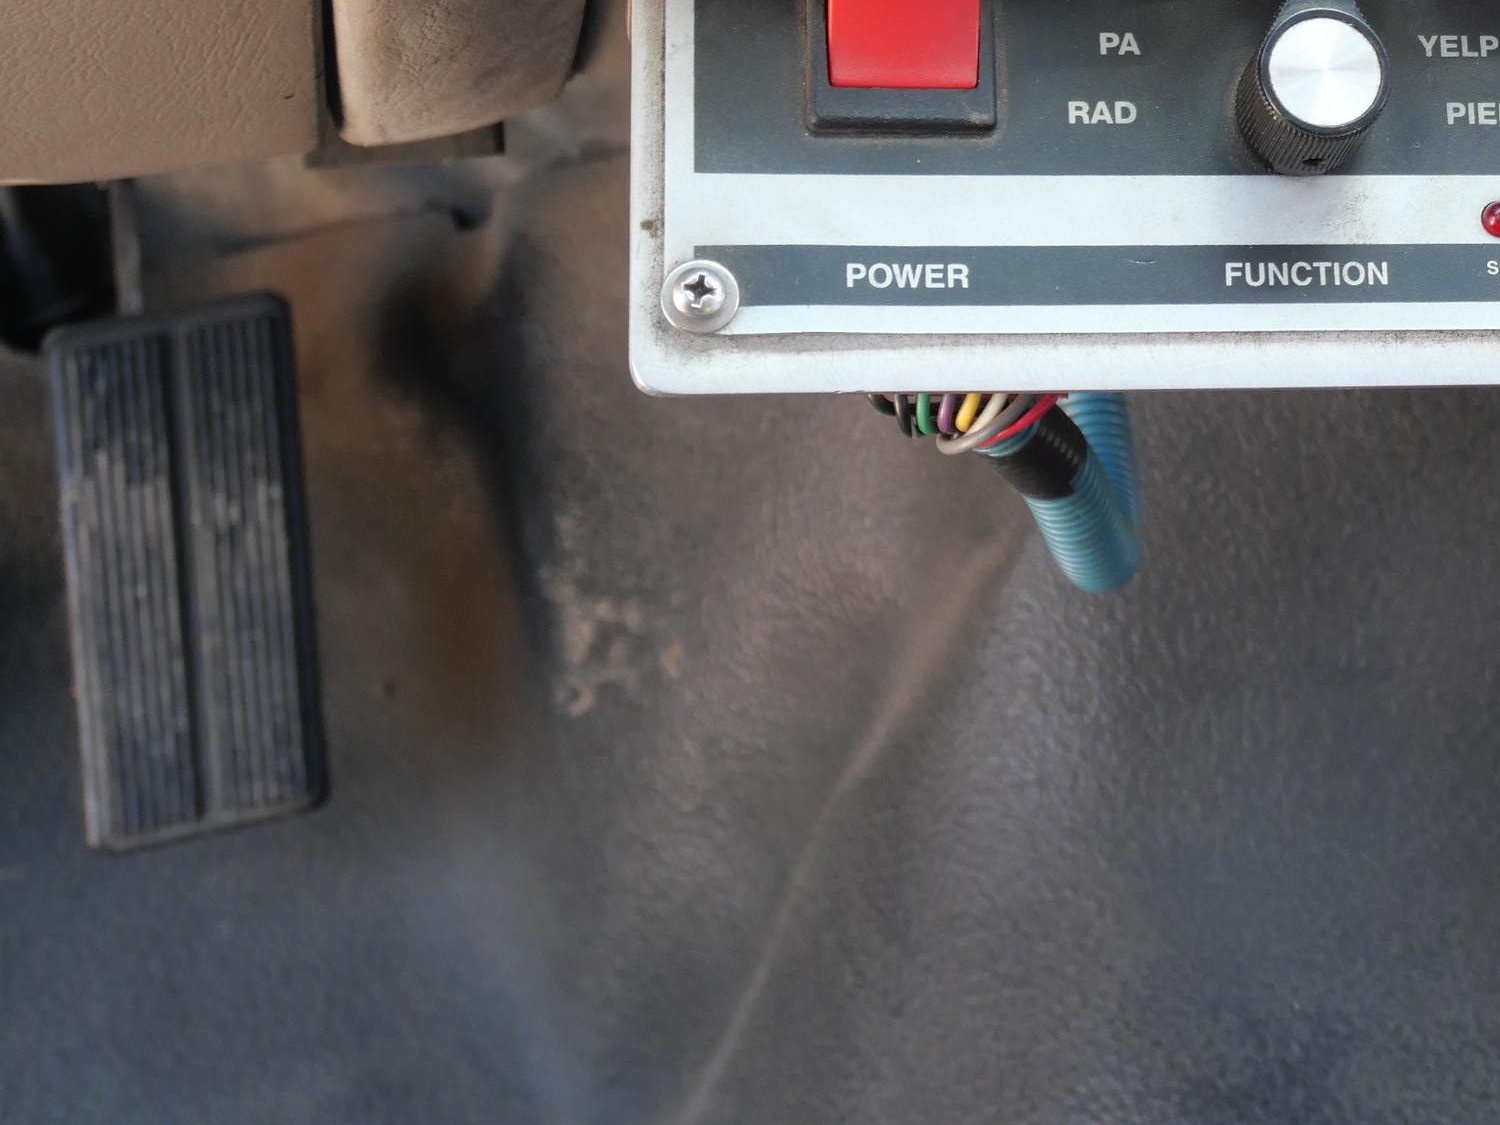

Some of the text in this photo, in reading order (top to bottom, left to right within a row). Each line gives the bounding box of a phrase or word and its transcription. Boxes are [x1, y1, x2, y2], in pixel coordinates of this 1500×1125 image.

[1099, 32, 1141, 55] PA
[1417, 35, 1500, 58] YELP
[1068, 101, 1137, 124] RAD
[846, 263, 970, 289] POWER
[1224, 261, 1389, 287] FUNCTION
